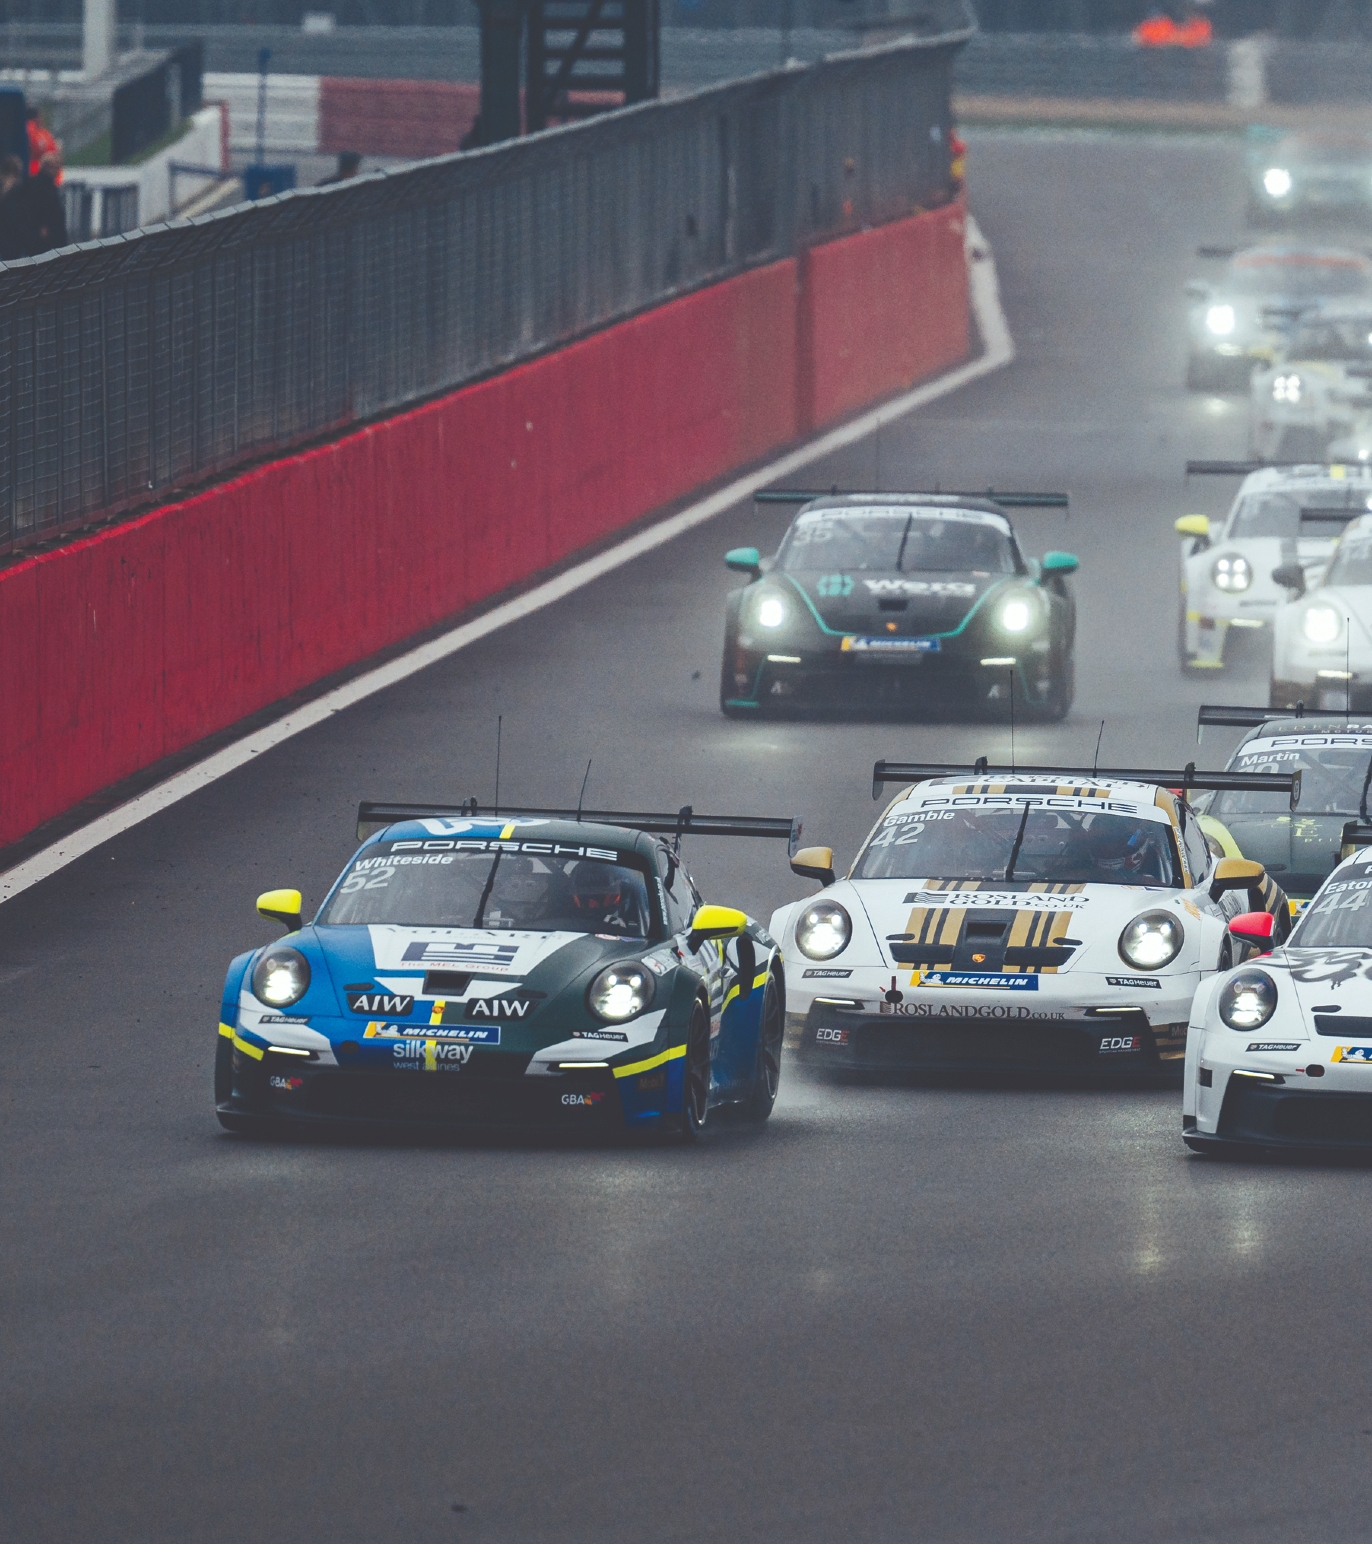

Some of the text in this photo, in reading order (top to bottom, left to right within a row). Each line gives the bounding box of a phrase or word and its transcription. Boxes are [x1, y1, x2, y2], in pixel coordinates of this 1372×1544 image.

[1240, 751, 1300, 767] Martin
[921, 797, 1138, 815] PORSCHE
[883, 810, 955, 828] Gamble
[870, 822, 926, 848] 42
[390, 840, 618, 861] PORSCHE
[355, 852, 454, 872] Whiteside
[340, 866, 396, 894] 52
[953, 893, 1090, 903] ROSLAND
[1312, 890, 1370, 916] 44
[465, 964, 509, 972] Group
[945, 976, 1029, 986] MICHELIN
[353, 994, 411, 1012] AIW
[472, 999, 530, 1017] AIW
[402, 1027, 489, 1039] MICHELIN
[816, 1028, 850, 1043] EDGE
[1100, 1036, 1142, 1050] EDGE
[393, 1061, 420, 1071] west
[270, 1076, 287, 1088] GBA
[561, 1094, 585, 1105] GBA
